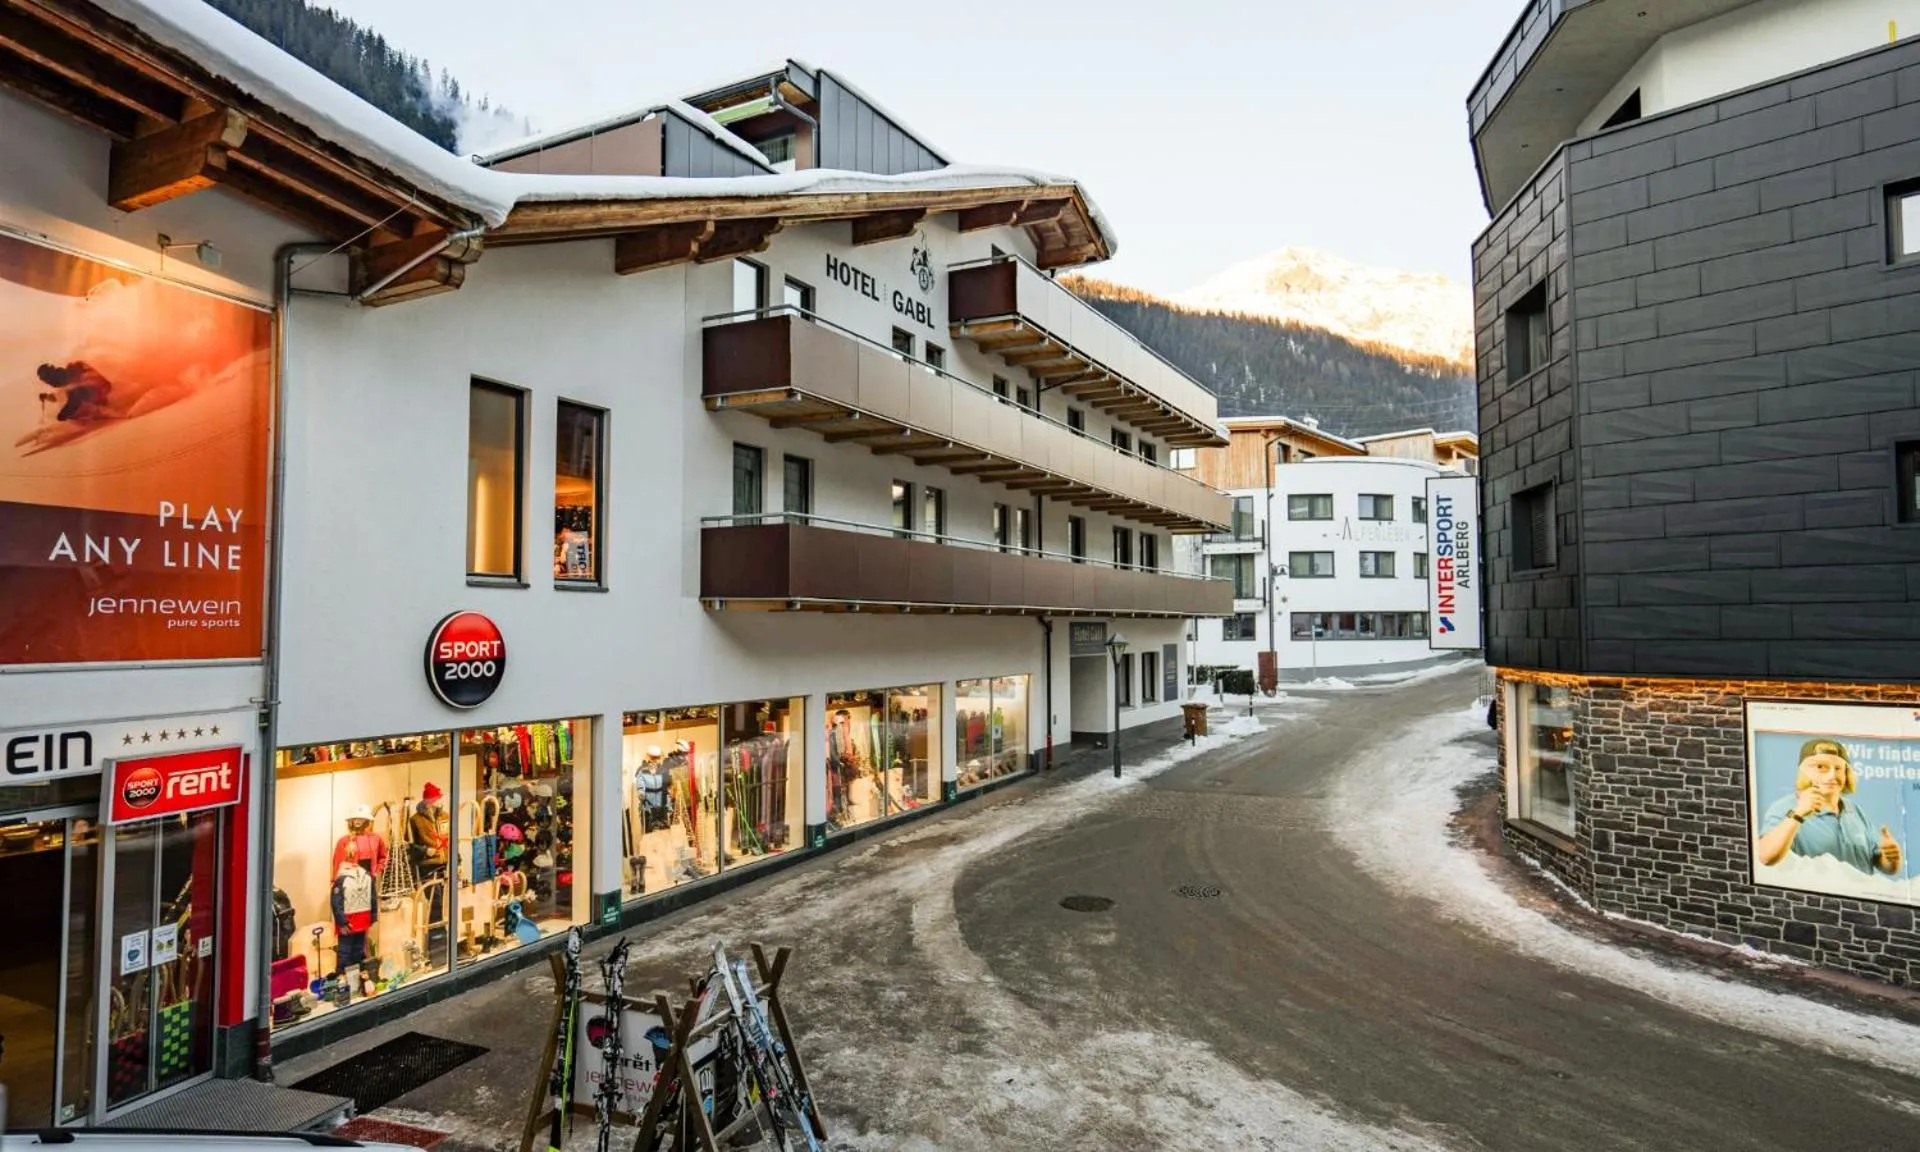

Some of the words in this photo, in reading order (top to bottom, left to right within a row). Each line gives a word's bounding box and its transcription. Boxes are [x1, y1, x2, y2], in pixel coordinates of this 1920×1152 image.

[826, 253, 880, 302] HOTEL
[892, 290, 935, 329] GABL
[159, 501, 243, 533] PLAY
[49, 531, 141, 565] ANY
[163, 540, 241, 571] LINE
[1436, 494, 1456, 614] INTERSPORT
[1455, 521, 1470, 589] ARLBERG
[88, 597, 241, 616] jennewein
[167, 619, 198, 629] pure
[201, 619, 240, 629] sports
[440, 640, 500, 659] SPORT
[445, 661, 496, 680] 2000
[1847, 743, 1873, 760] Wir
[127, 777, 159, 790] SPORT
[166, 762, 232, 799] rent
[129, 786, 156, 798] 2000
